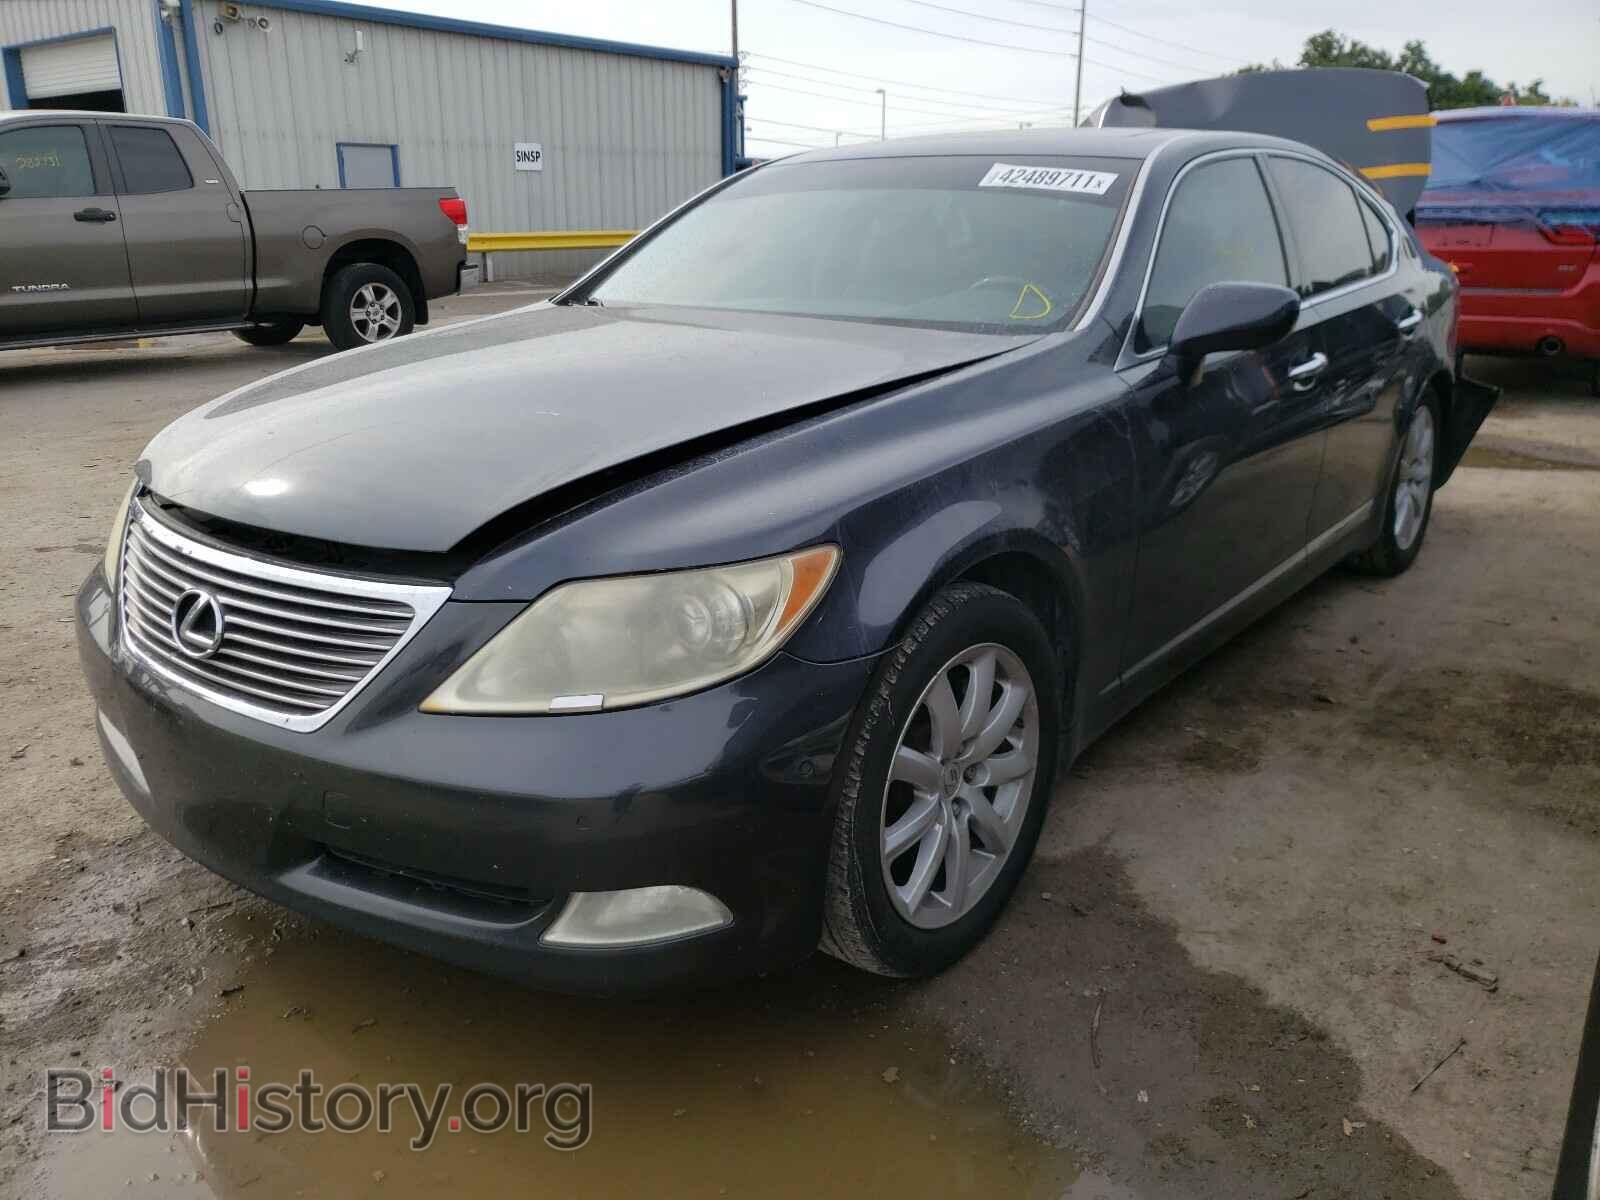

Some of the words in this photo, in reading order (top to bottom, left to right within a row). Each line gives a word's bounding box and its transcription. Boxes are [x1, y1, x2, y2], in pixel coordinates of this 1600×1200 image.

[516, 150, 541, 162] SINSP
[998, 168, 1095, 189] 42489711
[11, 283, 71, 292] TUNDRA
